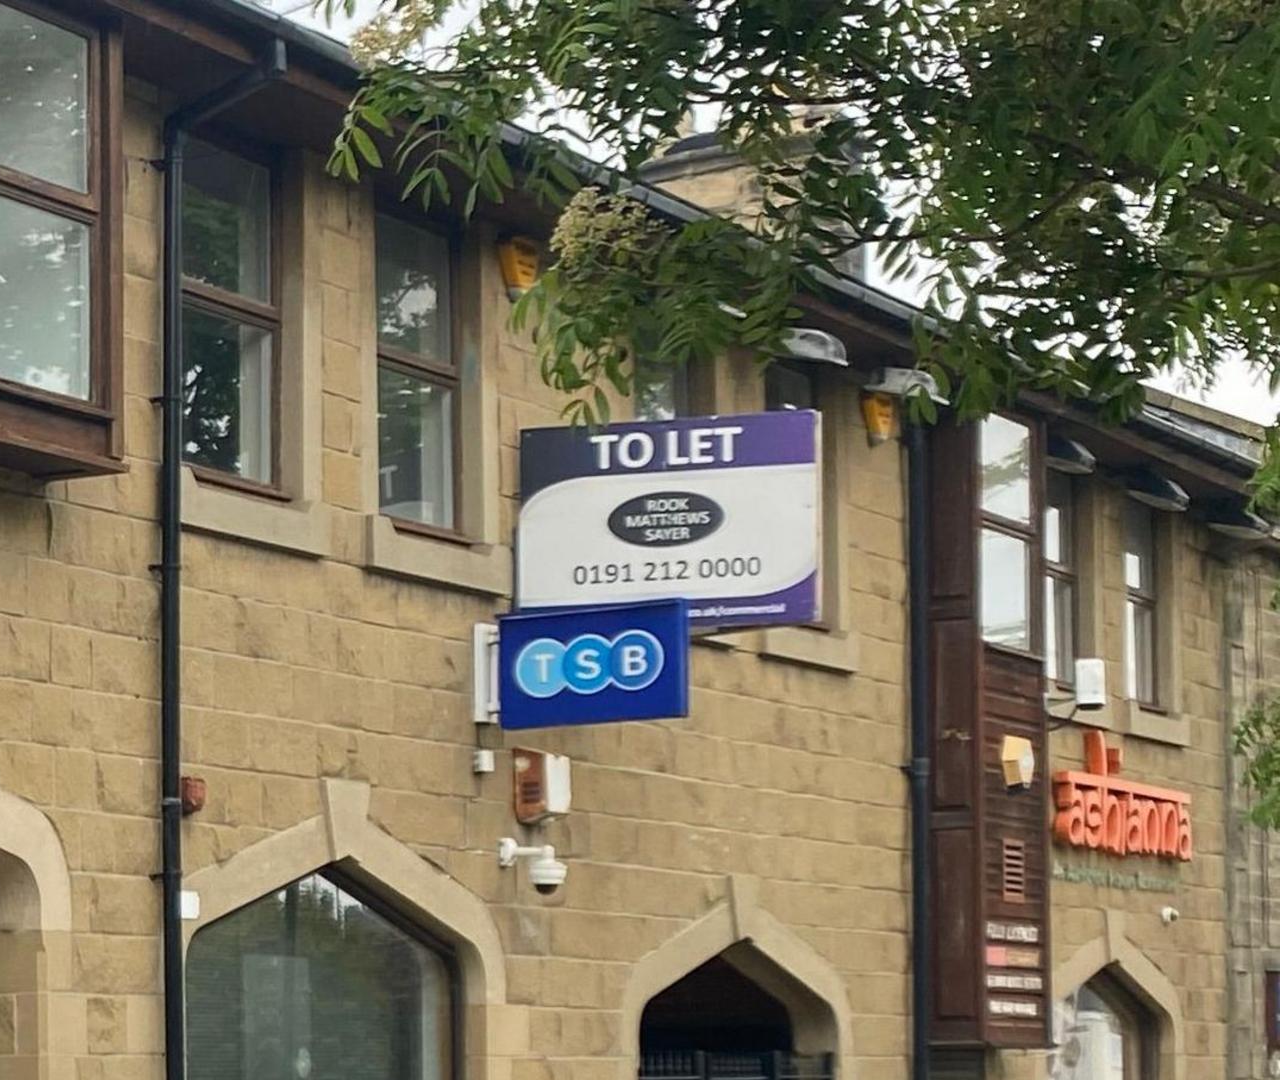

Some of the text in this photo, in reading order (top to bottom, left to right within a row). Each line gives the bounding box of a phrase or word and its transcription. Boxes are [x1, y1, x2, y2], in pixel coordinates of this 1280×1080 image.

[590, 426, 743, 470] TO LET
[645, 497, 690, 512] ROOK
[624, 510, 711, 529] MATTHEWS
[644, 526, 692, 542] SAYER
[572, 556, 762, 586] 0191 212 0000
[533, 644, 648, 684] TSB
